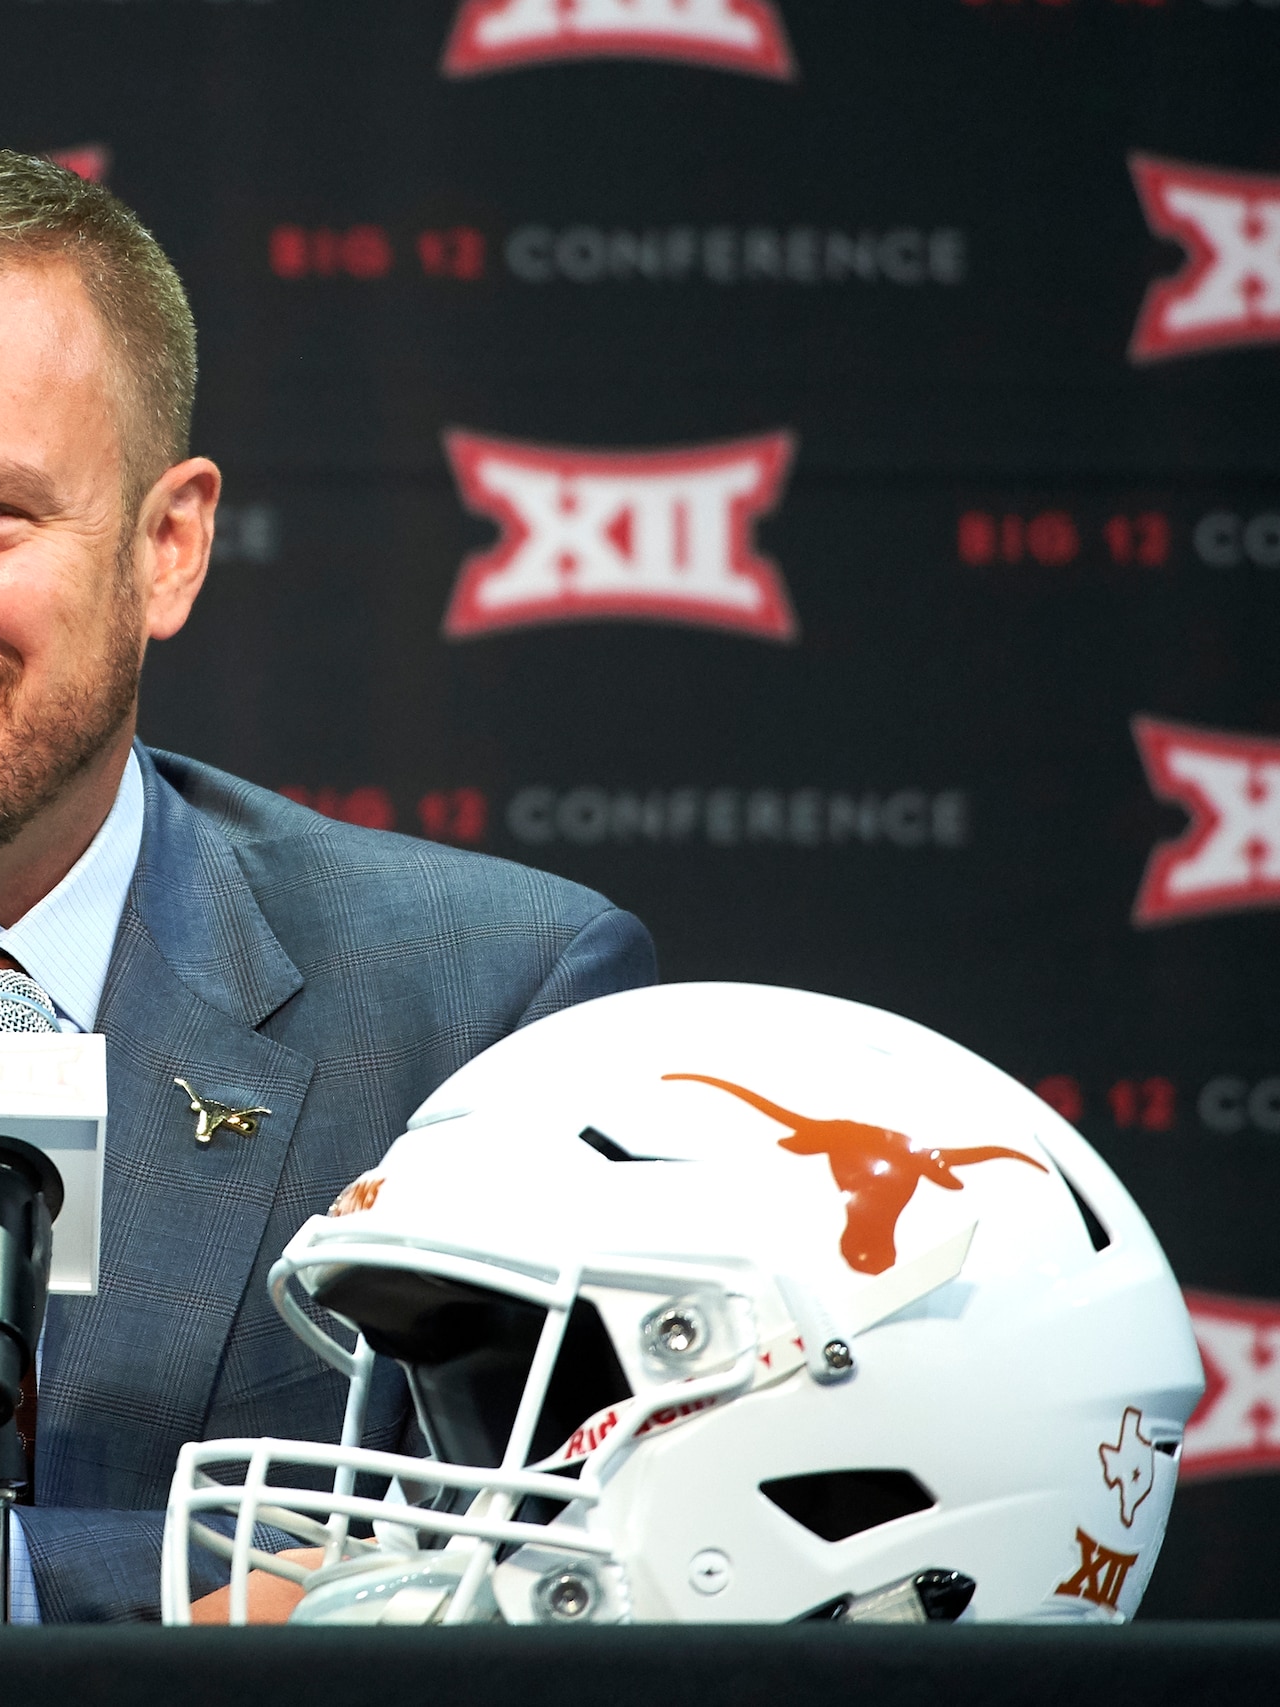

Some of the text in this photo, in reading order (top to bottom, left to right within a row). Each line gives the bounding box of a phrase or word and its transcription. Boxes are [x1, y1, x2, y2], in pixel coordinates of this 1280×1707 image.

[268, 225, 966, 283] BIG 12 CONFERENCE
[957, 510, 1080, 566] BIG
[1102, 512, 1172, 567] 12
[417, 787, 487, 842] 12
[507, 787, 968, 846] CONFERENCE
[1108, 1076, 1176, 1131] 12
[1053, 1525, 1138, 1612] XII
